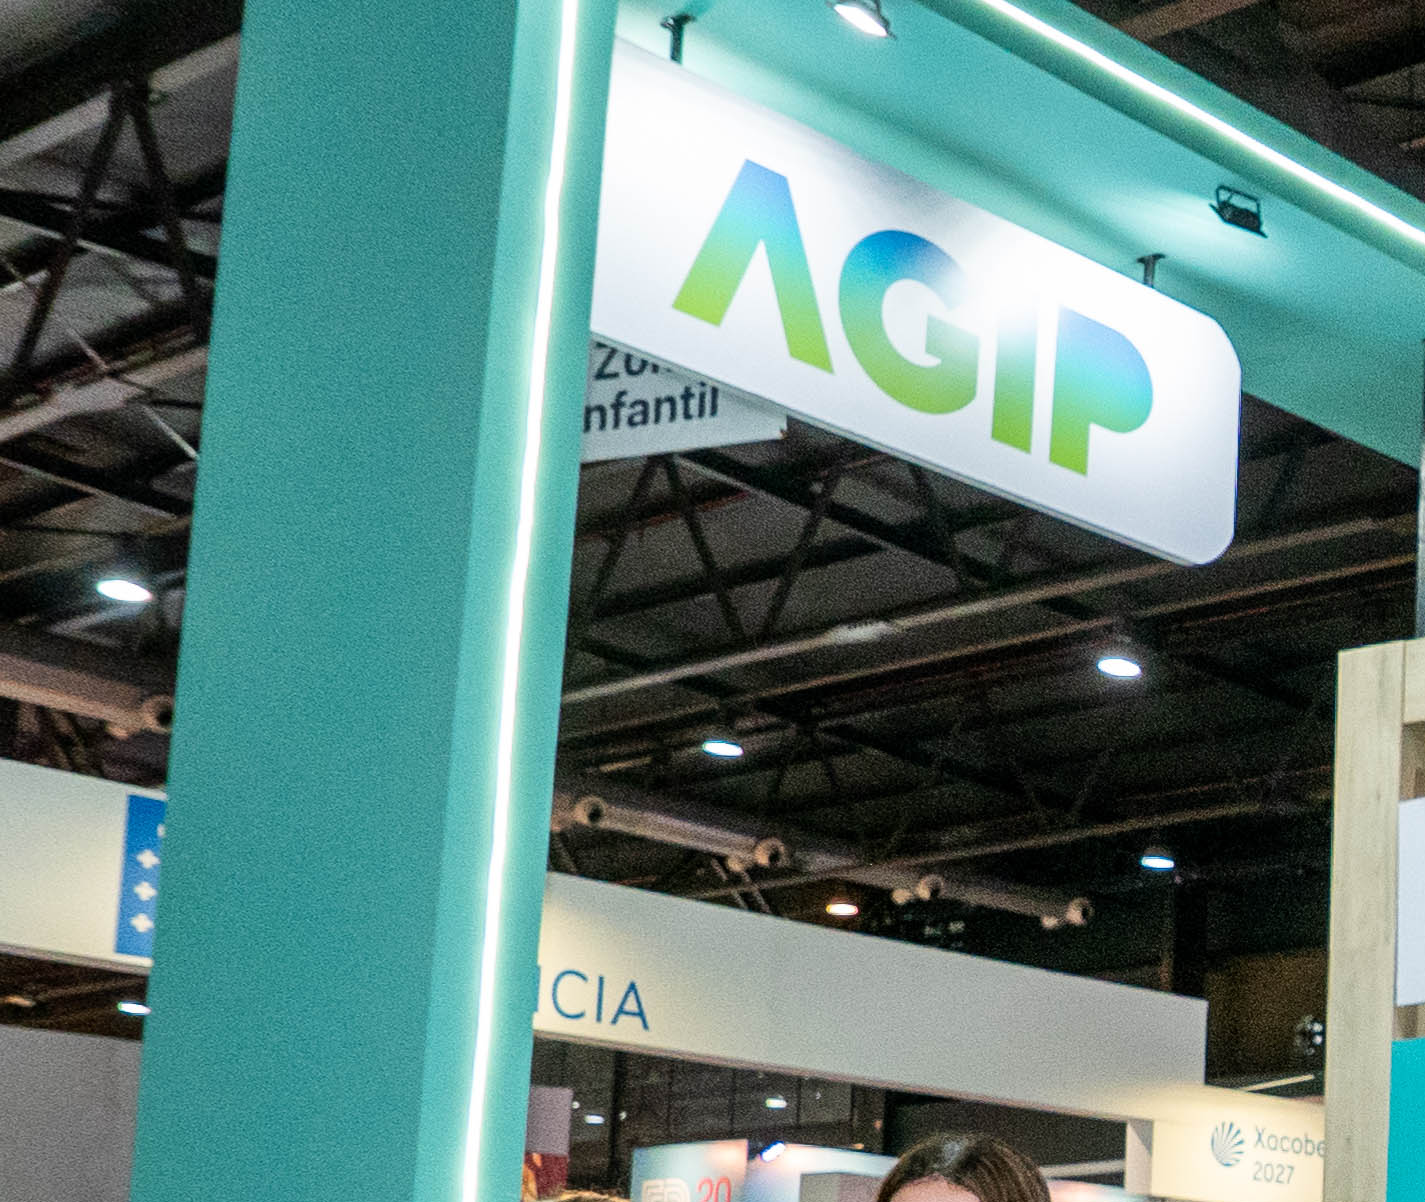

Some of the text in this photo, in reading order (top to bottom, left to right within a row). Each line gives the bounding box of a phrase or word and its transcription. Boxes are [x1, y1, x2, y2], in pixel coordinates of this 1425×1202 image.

[671, 158, 1153, 477] AGIP
[584, 381, 719, 433] nfantil
[1254, 1127, 1326, 1158] Xacobe
[1252, 1160, 1295, 1185] 2027
